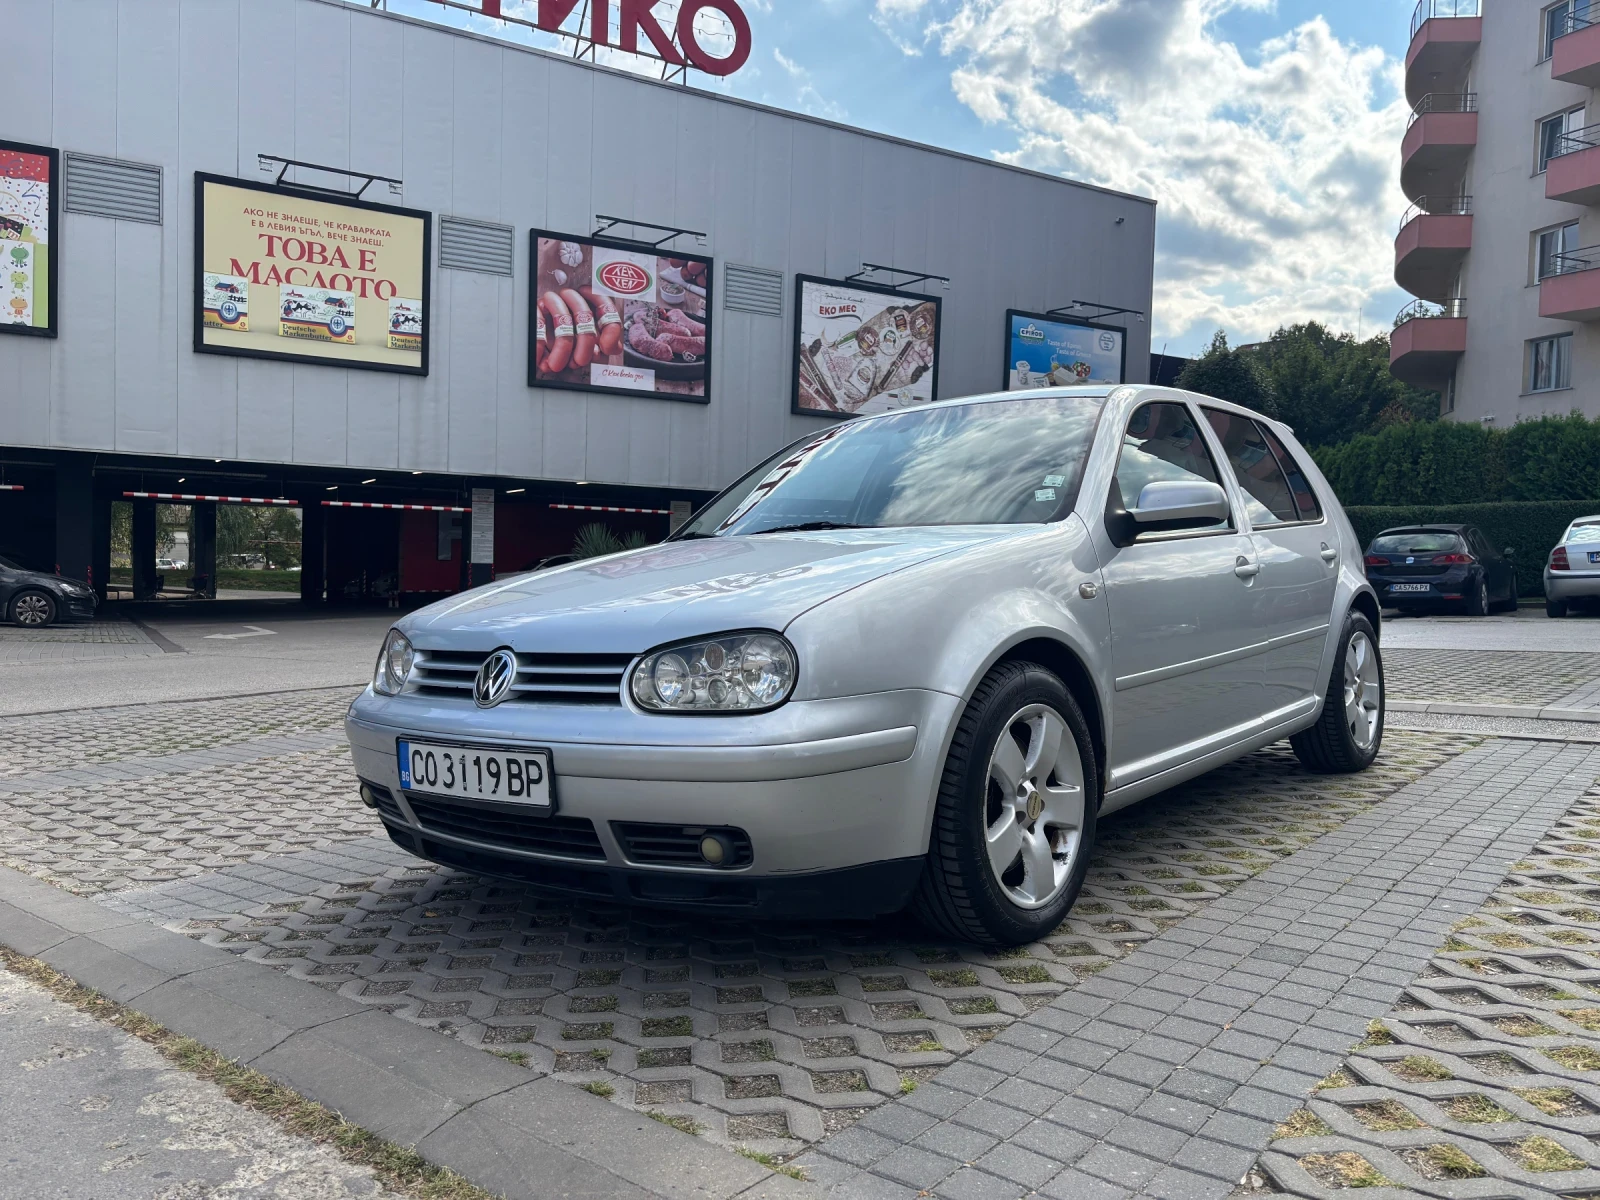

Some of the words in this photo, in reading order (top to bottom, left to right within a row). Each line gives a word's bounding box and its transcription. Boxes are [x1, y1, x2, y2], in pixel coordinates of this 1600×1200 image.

[243, 207, 264, 217] АКО
[266, 210, 279, 220] НЕ
[281, 213, 321, 228] ЗНАЕШЕ,
[323, 220, 335, 229] ЧЕ
[336, 222, 392, 238] КРАВАРКАТА
[251, 219, 257, 227] Е
[258, 220, 265, 228] В
[267, 221, 297, 233] ЛЕВИЯ
[298, 226, 325, 239] ЪГЪЛ,
[327, 231, 348, 242] ВЕЧЕ
[350, 235, 384, 247] ЗНАЕШ.
[258, 233, 352, 269] ТОВА
[358, 249, 377, 273] Е
[229, 257, 398, 301] МАСЛОТО
[819, 305, 837, 315] ЕКО
[838, 304, 857, 313] МЕС
[282, 323, 316, 333] Deutsche
[282, 329, 333, 341] Markenbutter
[401, 770, 410, 782] BG
